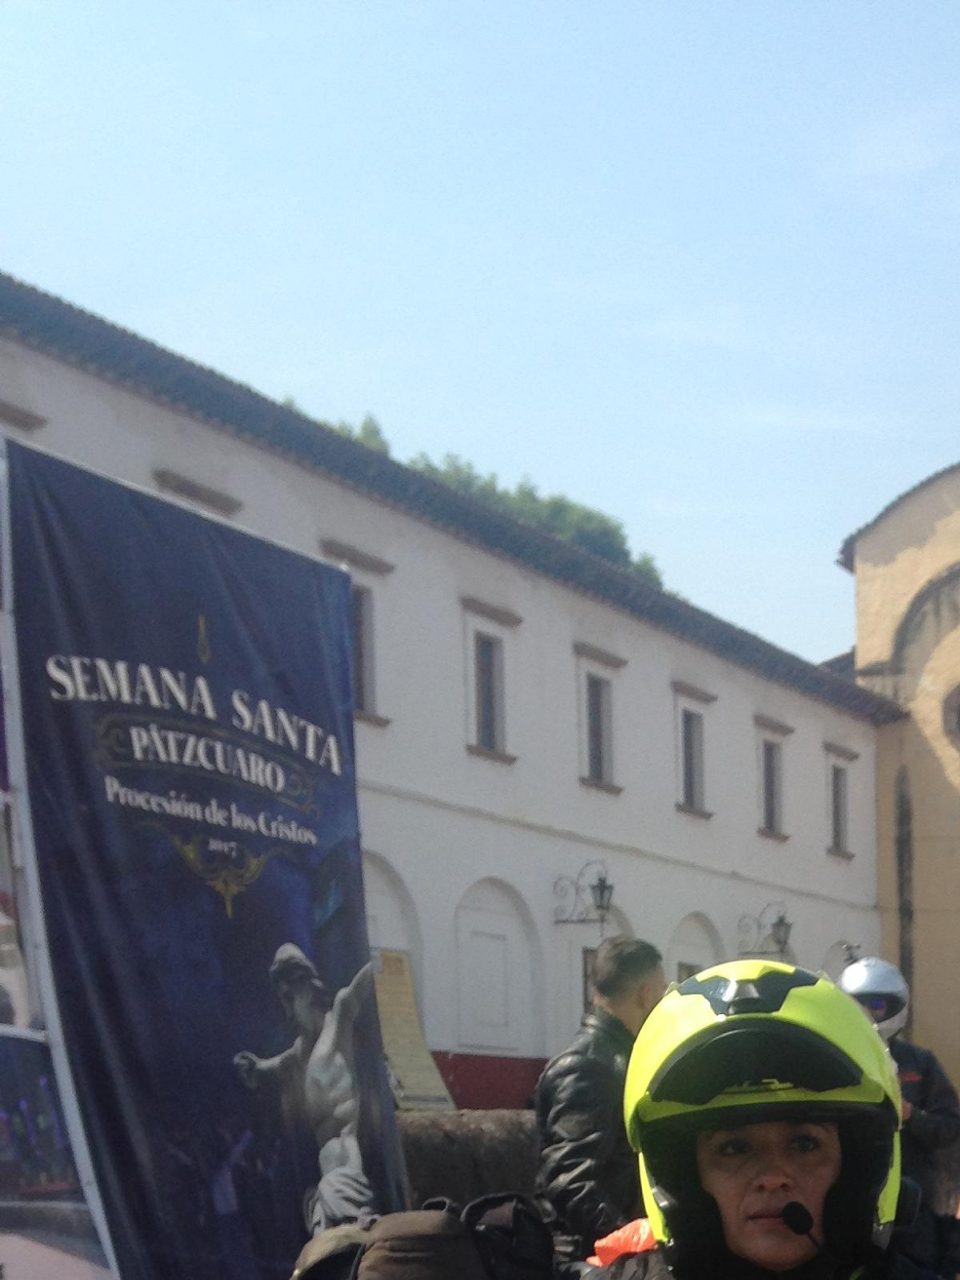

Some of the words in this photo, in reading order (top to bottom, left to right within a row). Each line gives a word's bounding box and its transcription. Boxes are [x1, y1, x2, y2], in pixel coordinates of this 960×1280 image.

[46, 653, 217, 720] SEMANA
[231, 687, 342, 776] SANTA
[104, 775, 201, 822] Procesión
[204, 798, 229, 827] de
[230, 802, 259, 832] los
[258, 811, 317, 846] Cristos
